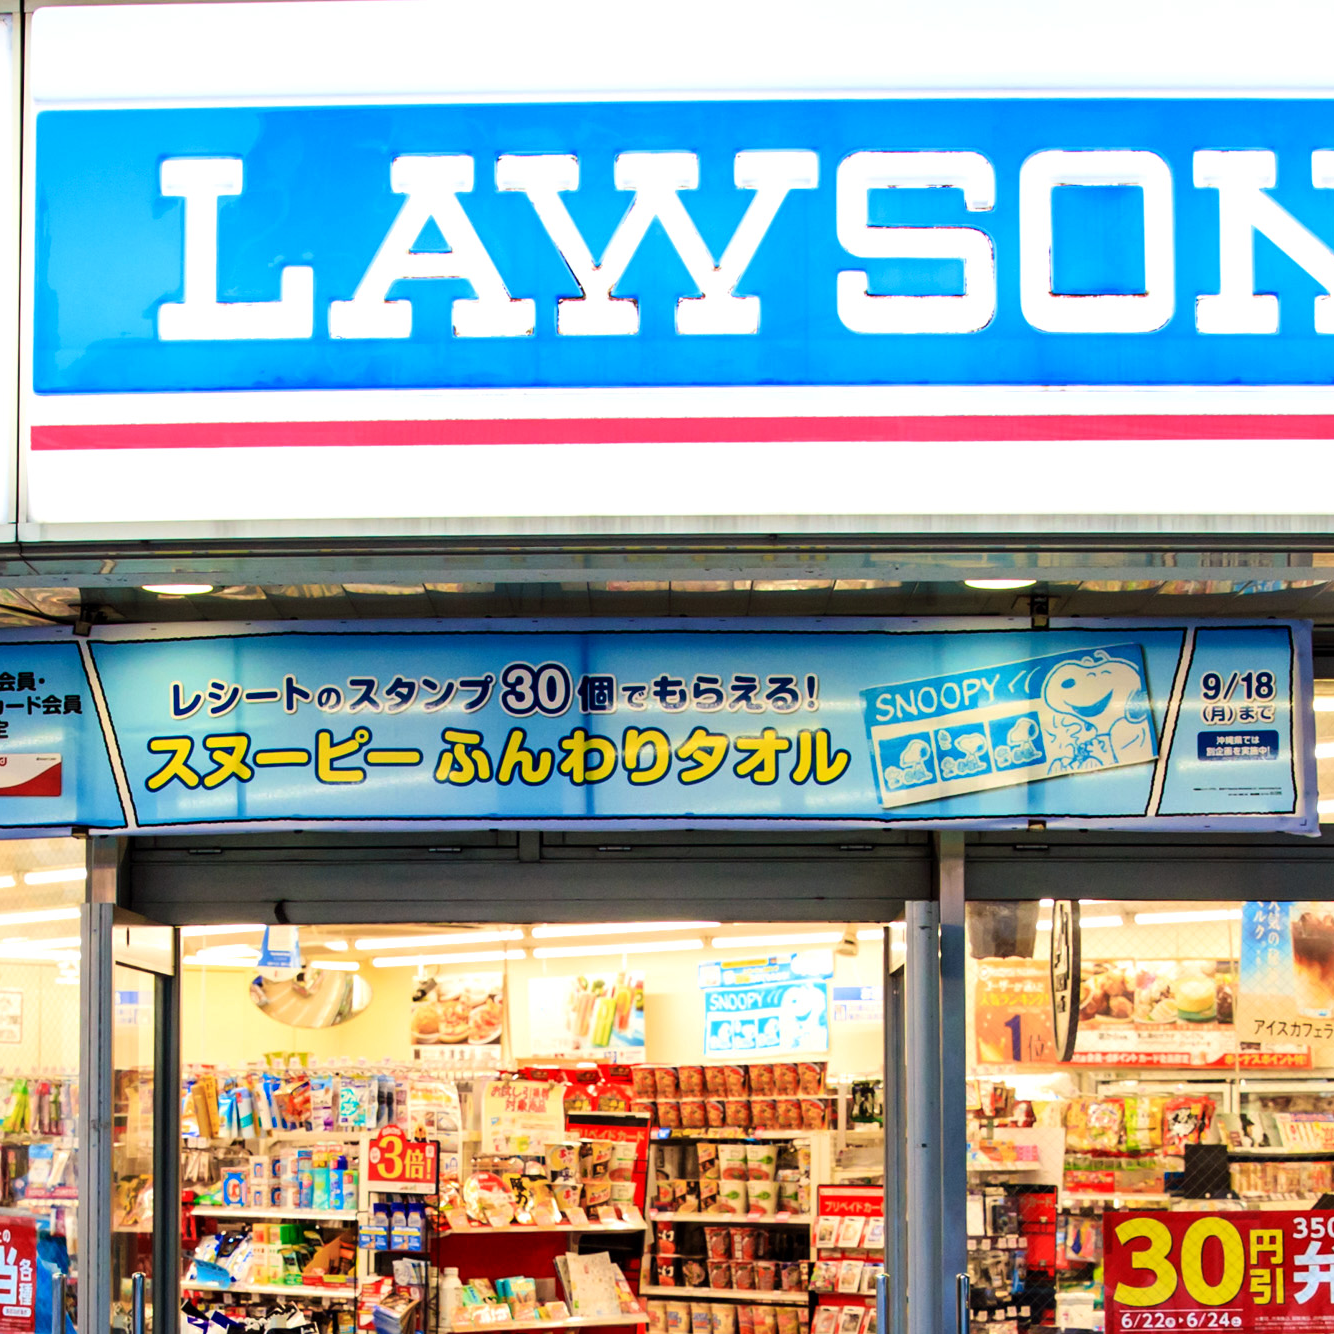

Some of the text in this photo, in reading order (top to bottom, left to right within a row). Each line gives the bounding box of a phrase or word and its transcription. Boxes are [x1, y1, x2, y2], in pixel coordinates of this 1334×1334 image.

[874, 673, 1000, 724] SNOOPY
[1201, 671, 1276, 701] 9/18
[1216, 736, 1260, 745] 沖縄県では
[709, 990, 764, 1012] SNOOPY
